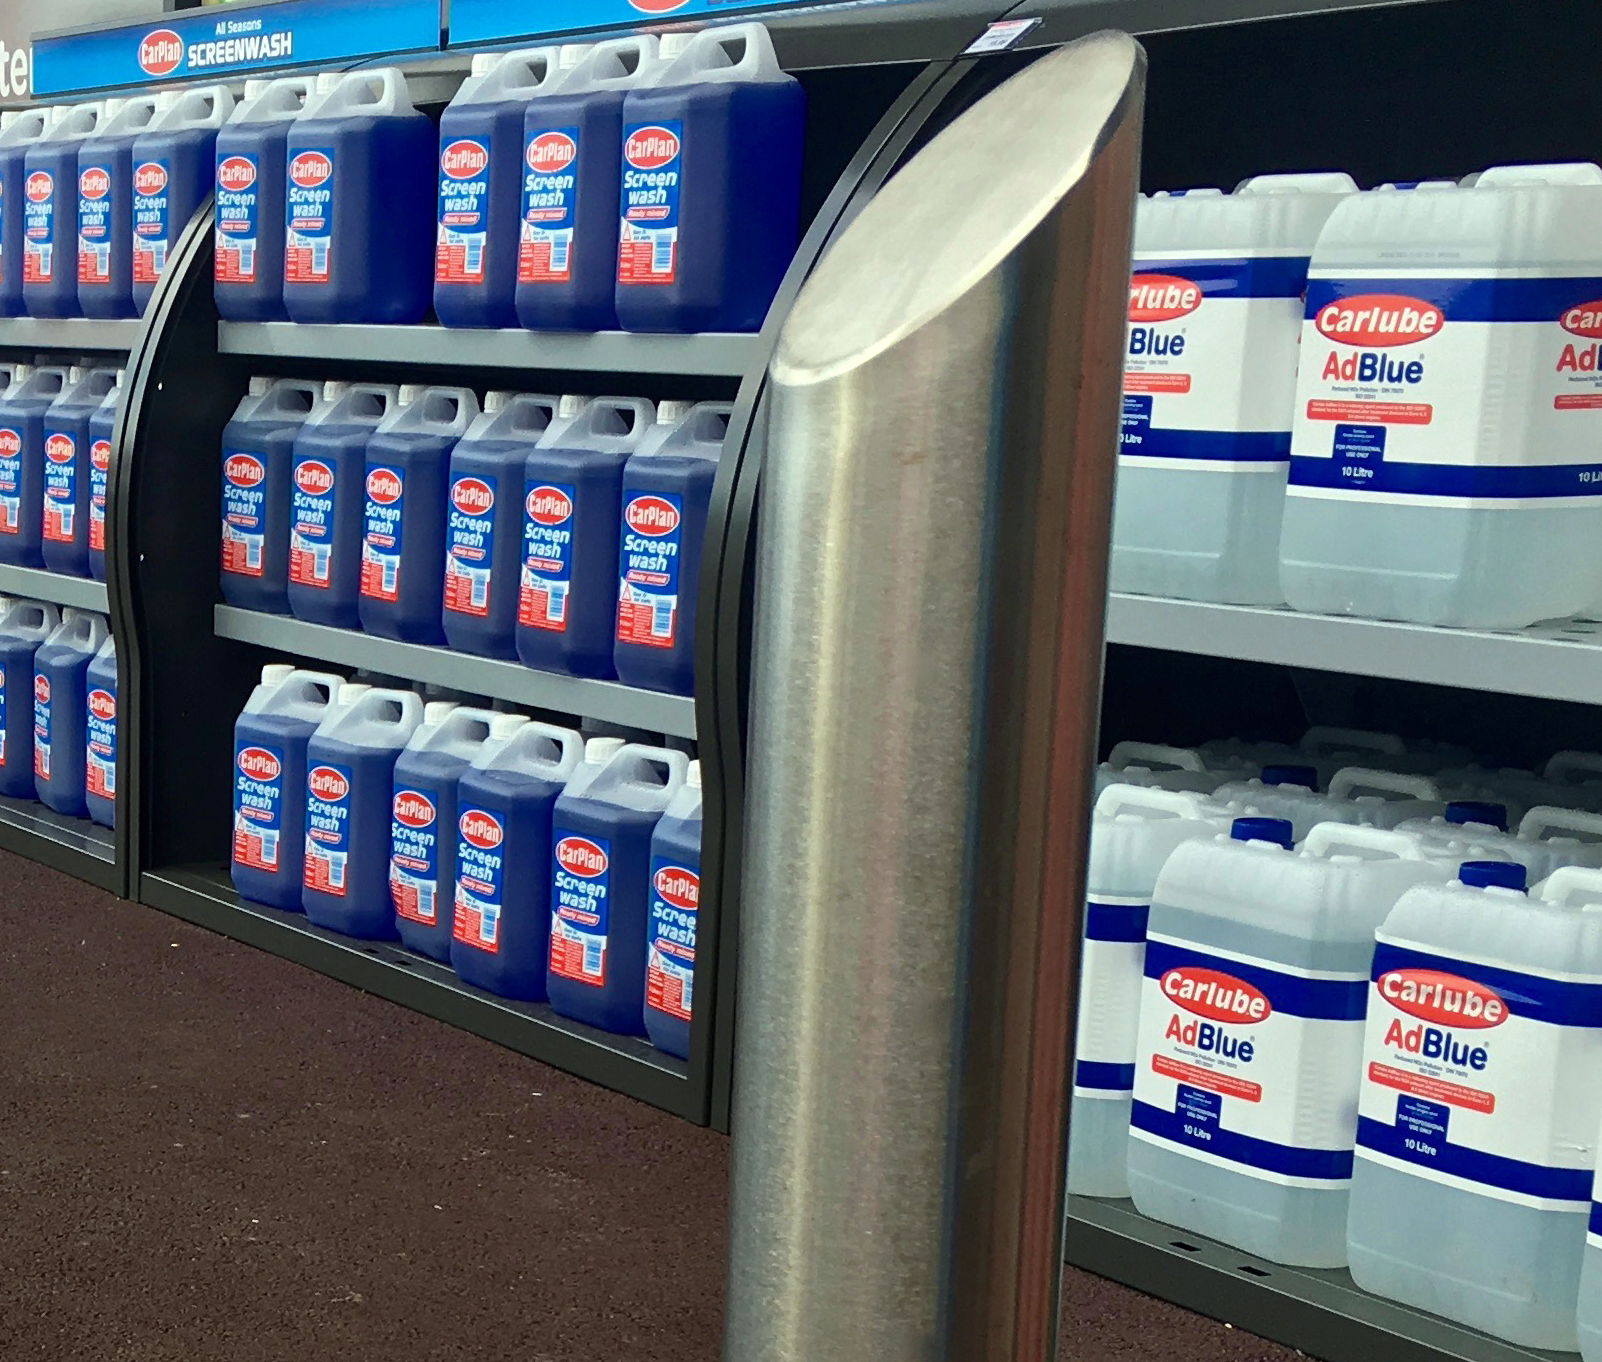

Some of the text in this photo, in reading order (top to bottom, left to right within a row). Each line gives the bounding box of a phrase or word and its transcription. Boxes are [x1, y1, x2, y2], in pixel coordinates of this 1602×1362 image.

[215, 19, 262, 36] All Seasons
[141, 40, 180, 64] CarPlan
[188, 32, 292, 69] SCREENWASH
[530, 143, 572, 162] CarPlan
[628, 136, 674, 158] CarPlan
[445, 150, 483, 169] CarPlan
[136, 170, 164, 187] CarPlan
[220, 166, 253, 182] CarPlan
[292, 161, 328, 178] CarPlan
[28, 180, 52, 194] CarPlan
[81, 175, 108, 191] CarPlan
[441, 180, 486, 196] Screen
[526, 174, 573, 191] Screen
[624, 171, 677, 188] Screen
[134, 198, 166, 211] Screen
[218, 192, 255, 205] Screen
[290, 188, 330, 203] Screen
[445, 195, 477, 211] wash
[530, 190, 564, 206] wash
[629, 187, 666, 204] wash
[26, 202, 52, 216] Screen
[79, 201, 109, 214] Screen
[137, 210, 160, 222] wash
[221, 207, 248, 218] wash
[293, 204, 322, 217] wash
[82, 212, 104, 225] wash
[1320, 306, 1438, 334] Carlube
[1129, 327, 1185, 356] Blue
[47, 441, 73, 456] CarPlan
[46, 462, 74, 476] Screen
[227, 462, 261, 479] CarPlan
[297, 468, 330, 486] CarPlan
[1342, 466, 1374, 478] 10 Litre
[48, 475, 68, 487] wash
[369, 476, 399, 495] CarPlan
[224, 486, 262, 503] Screen
[294, 493, 331, 511] Screen
[454, 486, 490, 506] CarPlan
[228, 501, 256, 516] wash
[365, 502, 400, 521] Screen
[529, 495, 568, 516] CarPlan
[298, 510, 324, 524] wash
[450, 513, 491, 534] Screen
[629, 504, 676, 527] CarPlan
[368, 519, 393, 534] wash
[525, 523, 570, 543] Screen
[454, 529, 483, 547] wash
[625, 535, 677, 556] Screen
[529, 541, 561, 558] wash
[630, 553, 667, 572] wash
[88, 717, 115, 735] Screen
[240, 754, 278, 774] CarPlan
[238, 777, 279, 799] Screen
[311, 773, 346, 794] CarPlan
[242, 793, 272, 810] wash
[308, 798, 347, 819] Screen
[395, 798, 433, 820] CarPlan
[311, 814, 339, 831] wash
[462, 818, 501, 842] CarPlan
[392, 823, 434, 846] Screen
[394, 840, 426, 859] wash
[459, 843, 500, 869] Screen
[559, 846, 605, 871] CarPlan
[462, 861, 493, 882] wash
[555, 872, 606, 898] Screen
[560, 892, 596, 912] wash
[653, 902, 696, 927] Scree
[1164, 972, 1265, 1019] Carlube
[1383, 973, 1502, 1022] Carlube
[1184, 1124, 1212, 1140] 10 Litre
[1405, 1138, 1437, 1156] 10 Litre
